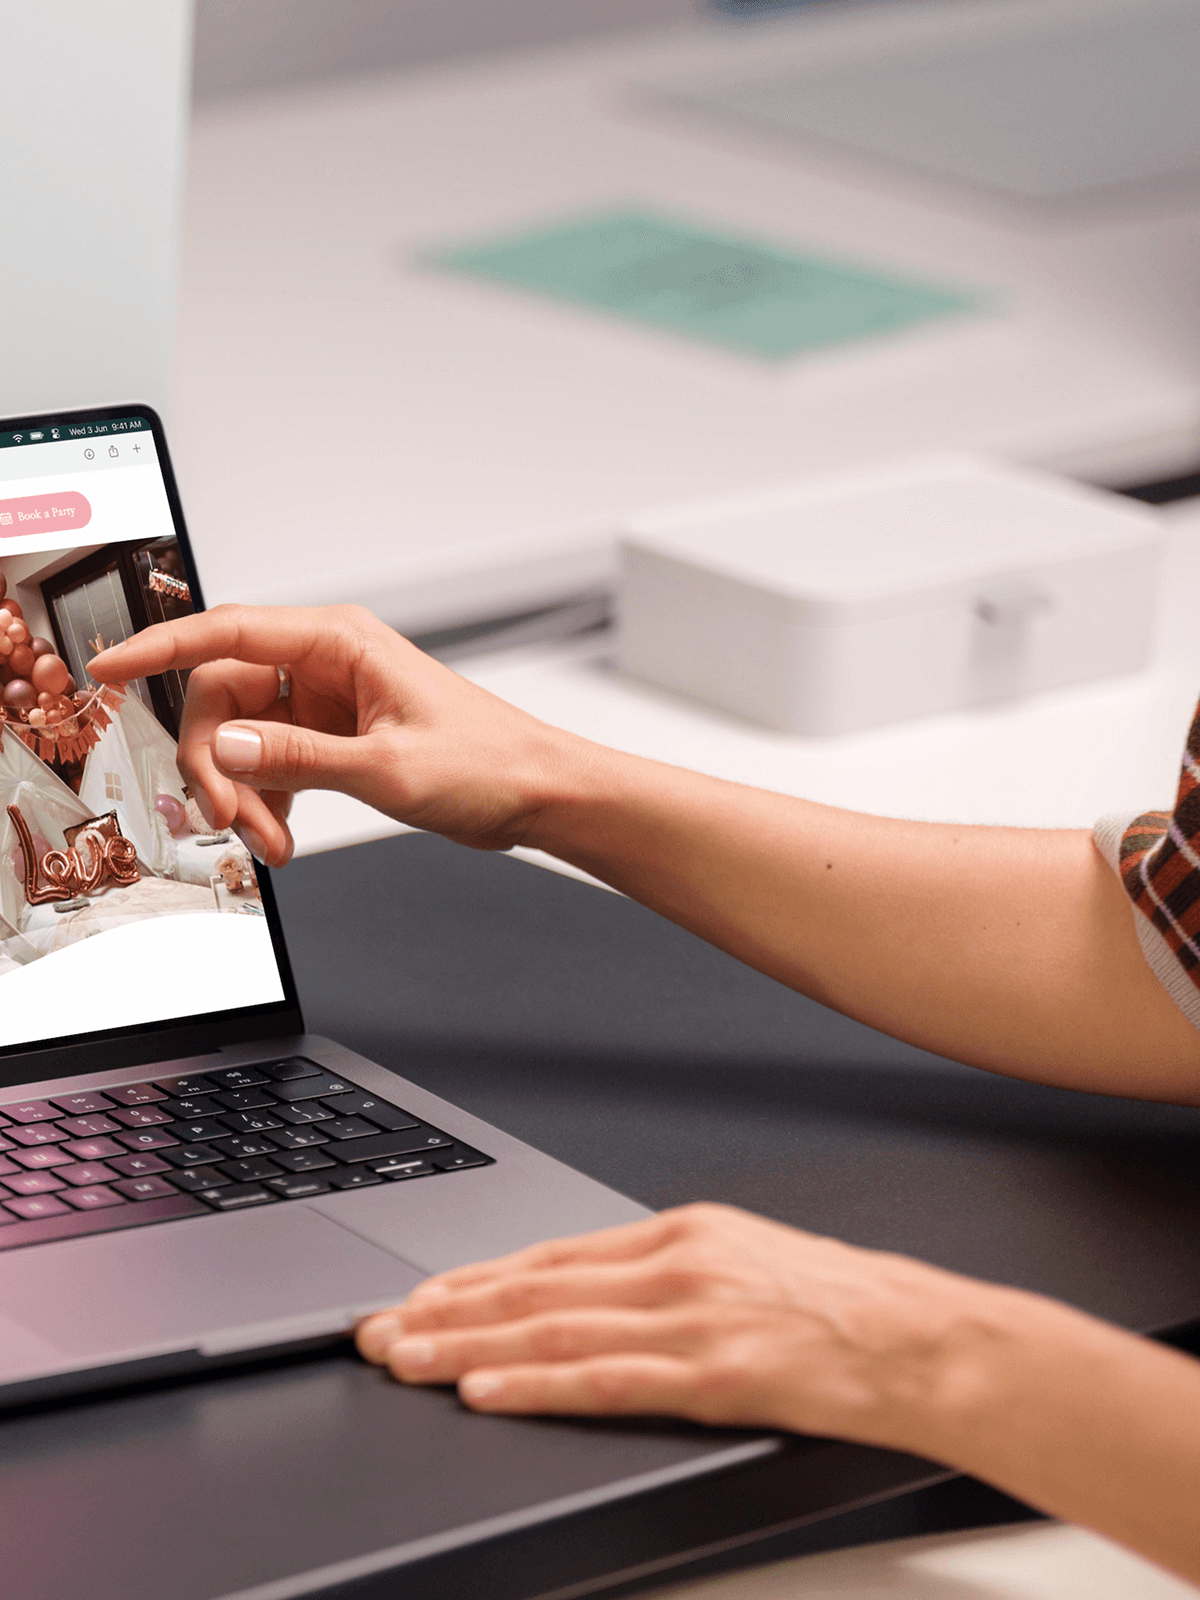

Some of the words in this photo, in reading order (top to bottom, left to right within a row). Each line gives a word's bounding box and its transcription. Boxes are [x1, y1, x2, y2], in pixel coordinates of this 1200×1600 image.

[68, 426, 86, 436] Wed
[86, 425, 93, 434] 3
[94, 425, 108, 433] Jun
[111, 422, 128, 431] 9:41
[129, 420, 142, 429] AM
[17, 508, 42, 522] Book
[43, 510, 50, 518] a
[52, 505, 76, 518] Party
[6, 803, 142, 906] Love
